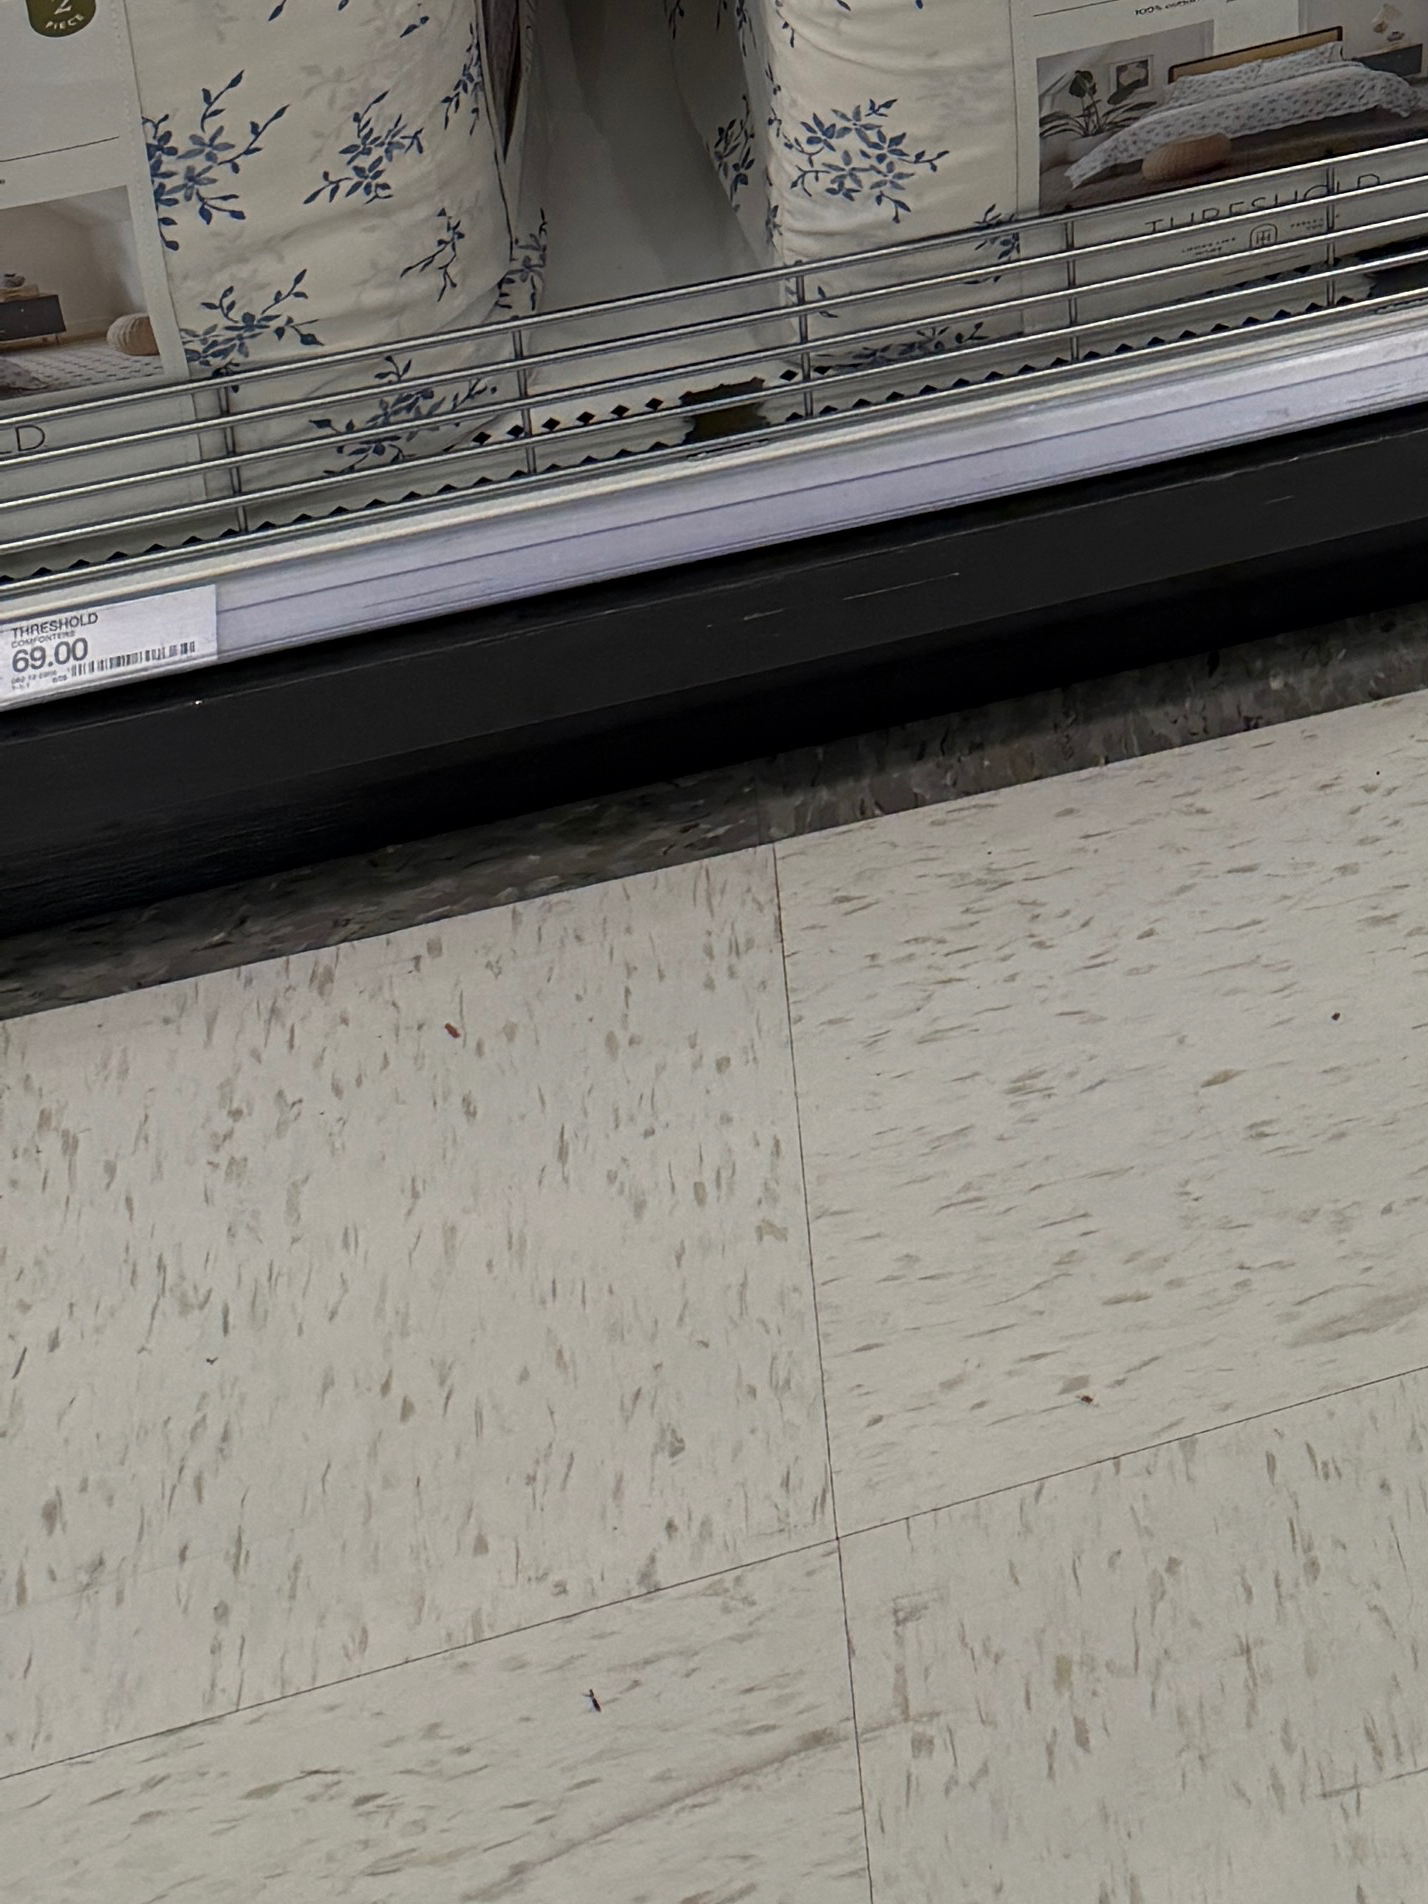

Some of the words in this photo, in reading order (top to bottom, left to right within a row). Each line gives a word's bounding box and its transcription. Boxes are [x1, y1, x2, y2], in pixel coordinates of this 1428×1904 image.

[45, 14, 84, 29] PIECE
[11, 612, 99, 640] THRESHOLD
[12, 637, 88, 673] 69.00
